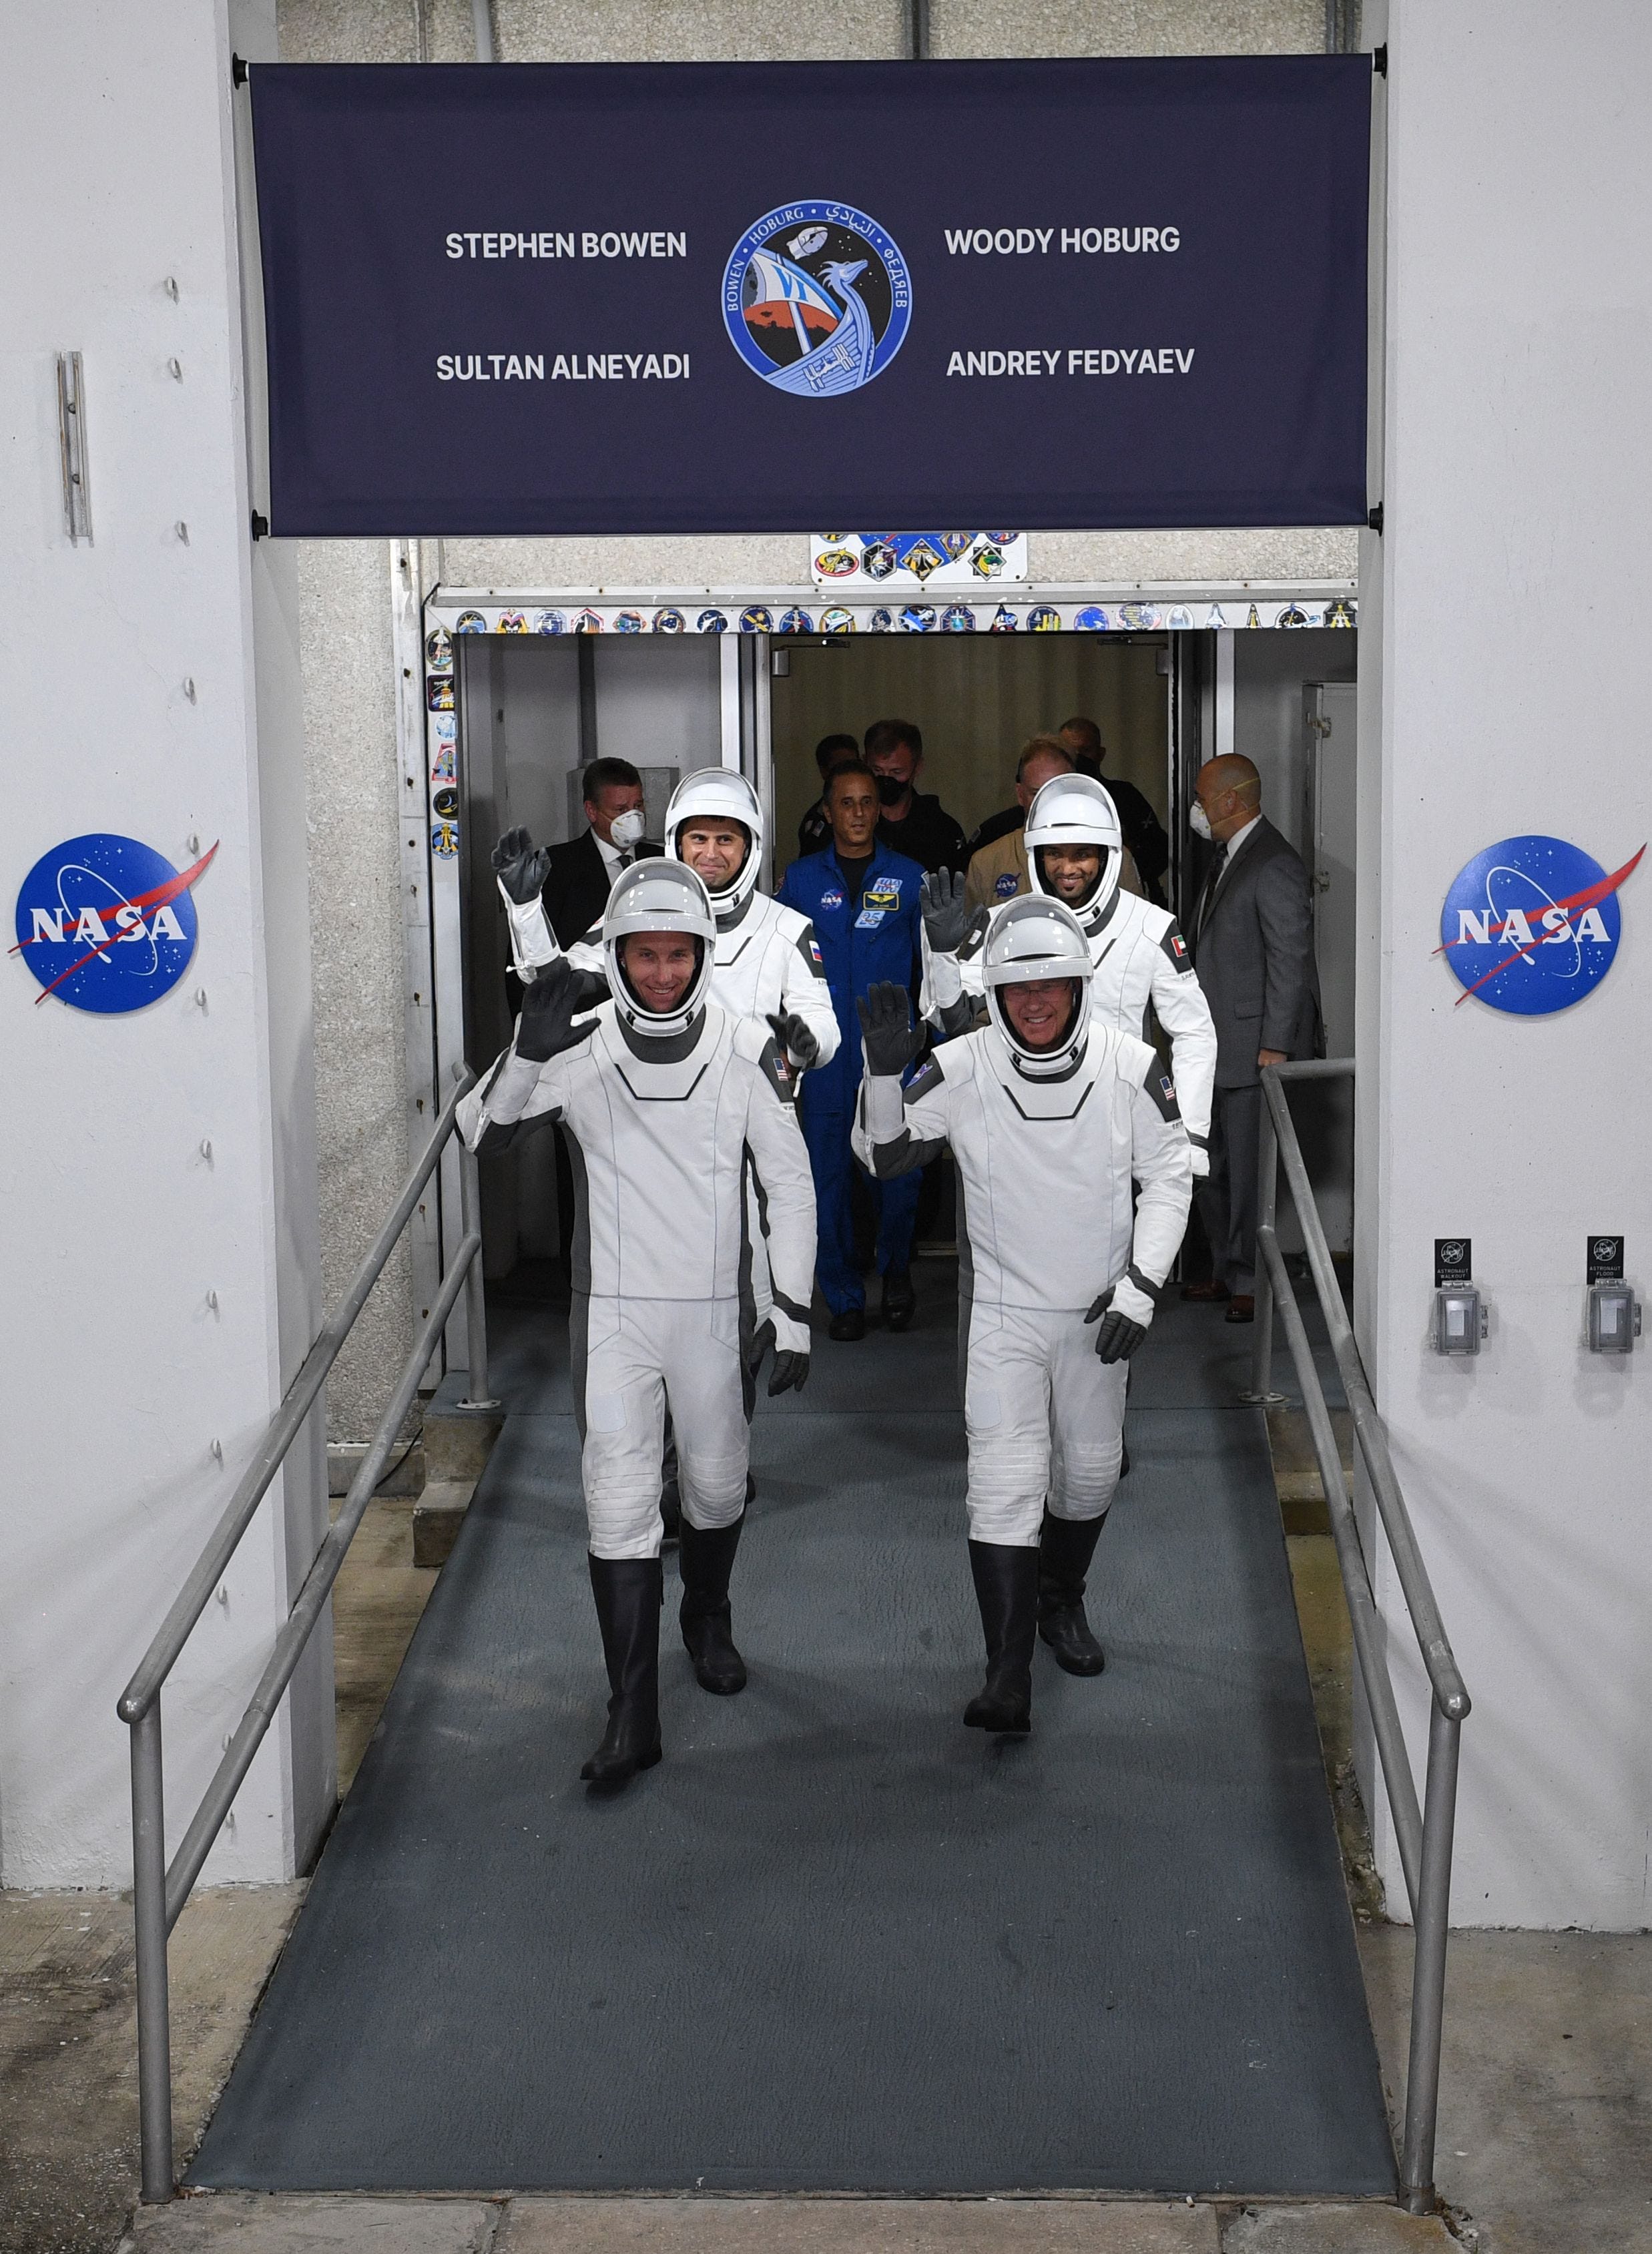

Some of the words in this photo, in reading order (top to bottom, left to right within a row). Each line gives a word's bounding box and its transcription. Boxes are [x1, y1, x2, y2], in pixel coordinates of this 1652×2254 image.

[748, 206, 804, 245] HOBURG
[446, 232, 575, 258] STEPHEN
[581, 232, 686, 258] BOWEN
[944, 228, 1055, 254] WOODY
[1061, 227, 1180, 253] HOBURG
[727, 258, 745, 312] BOWEN
[884, 248, 908, 308] ФЕДЯЕВ
[437, 354, 544, 380] SULTAN
[551, 354, 690, 380] ALNEYADI
[946, 350, 1061, 376] ANDREY
[1068, 348, 1195, 375] FEDYAEV
[997, 881, 1017, 889] NASA
[820, 896, 842, 904] NASA
[29, 904, 188, 942] NASA
[1456, 906, 1612, 944] NASA
